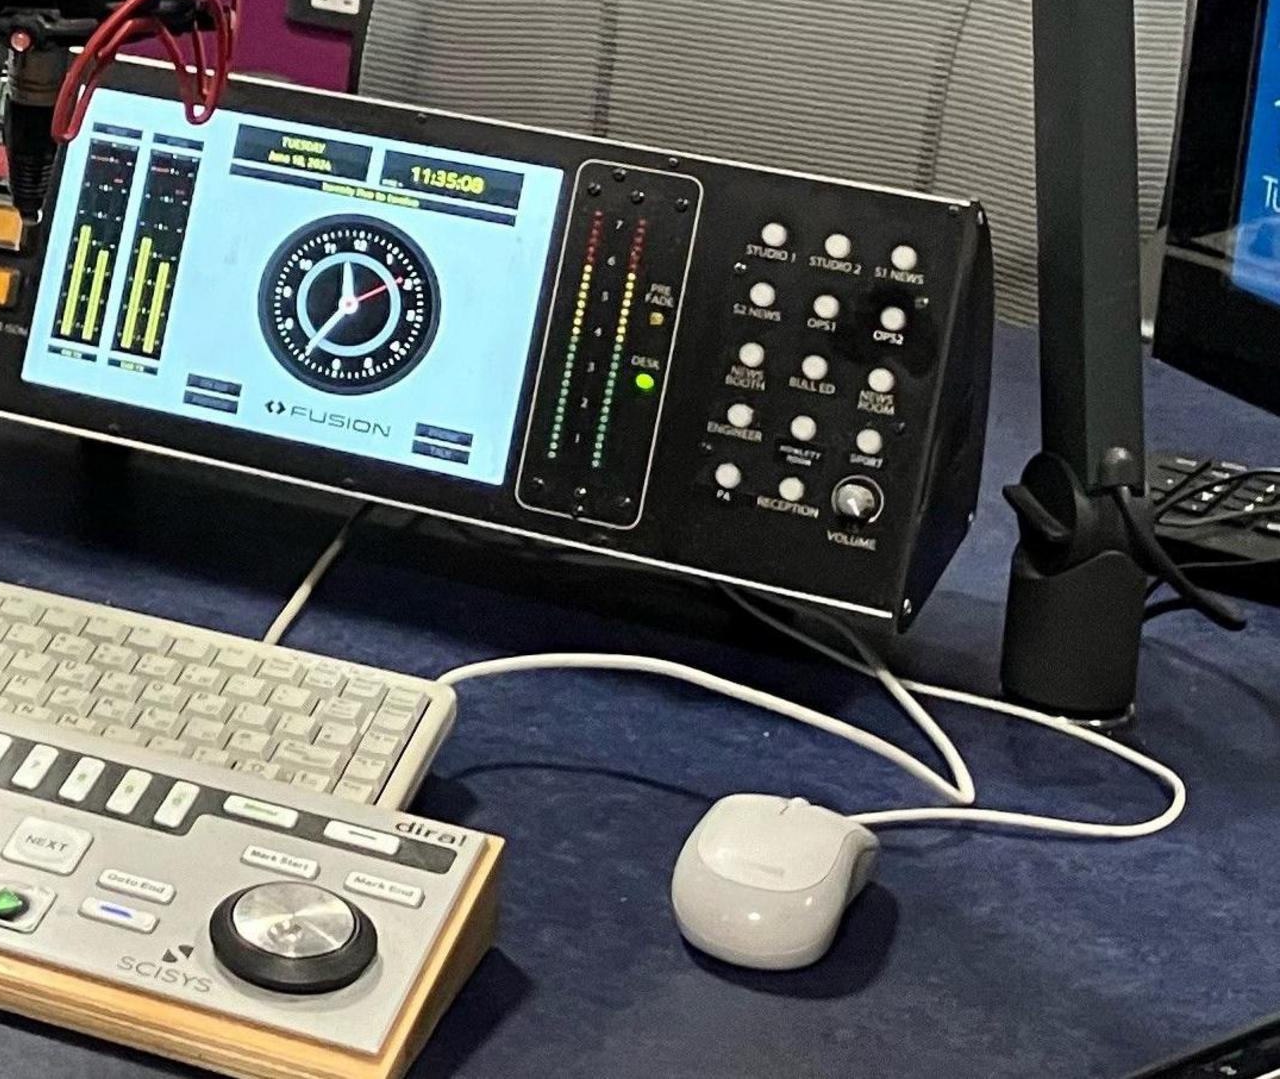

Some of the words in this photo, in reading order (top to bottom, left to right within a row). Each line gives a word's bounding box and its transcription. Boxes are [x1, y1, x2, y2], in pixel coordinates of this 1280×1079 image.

[411, 166, 486, 195] 11:35:08
[746, 244, 788, 261] STUDIO
[607, 256, 616, 266] 6
[809, 256, 852, 273] STUDIO
[853, 263, 863, 276] 2
[889, 270, 925, 285] NEWS
[650, 283, 671, 297] PRE
[645, 292, 674, 308] FADE
[748, 307, 782, 322] NEWS
[630, 355, 660, 369] DESK
[731, 366, 765, 380] NEWS
[725, 374, 766, 391] BOOTH
[580, 397, 589, 408] 2
[860, 390, 895, 404] NEWS
[857, 400, 896, 416] ROOM
[291, 406, 392, 438] FUSION
[707, 421, 763, 442] ENGINEER
[716, 489, 731, 501] PA
[757, 495, 820, 519] RECEPTION
[827, 530, 877, 551] VOLUME
[25, 834, 68, 852] NEXT
[107, 872, 138, 887] Goto
[140, 881, 167, 894] End
[116, 955, 213, 994] SCISYS
